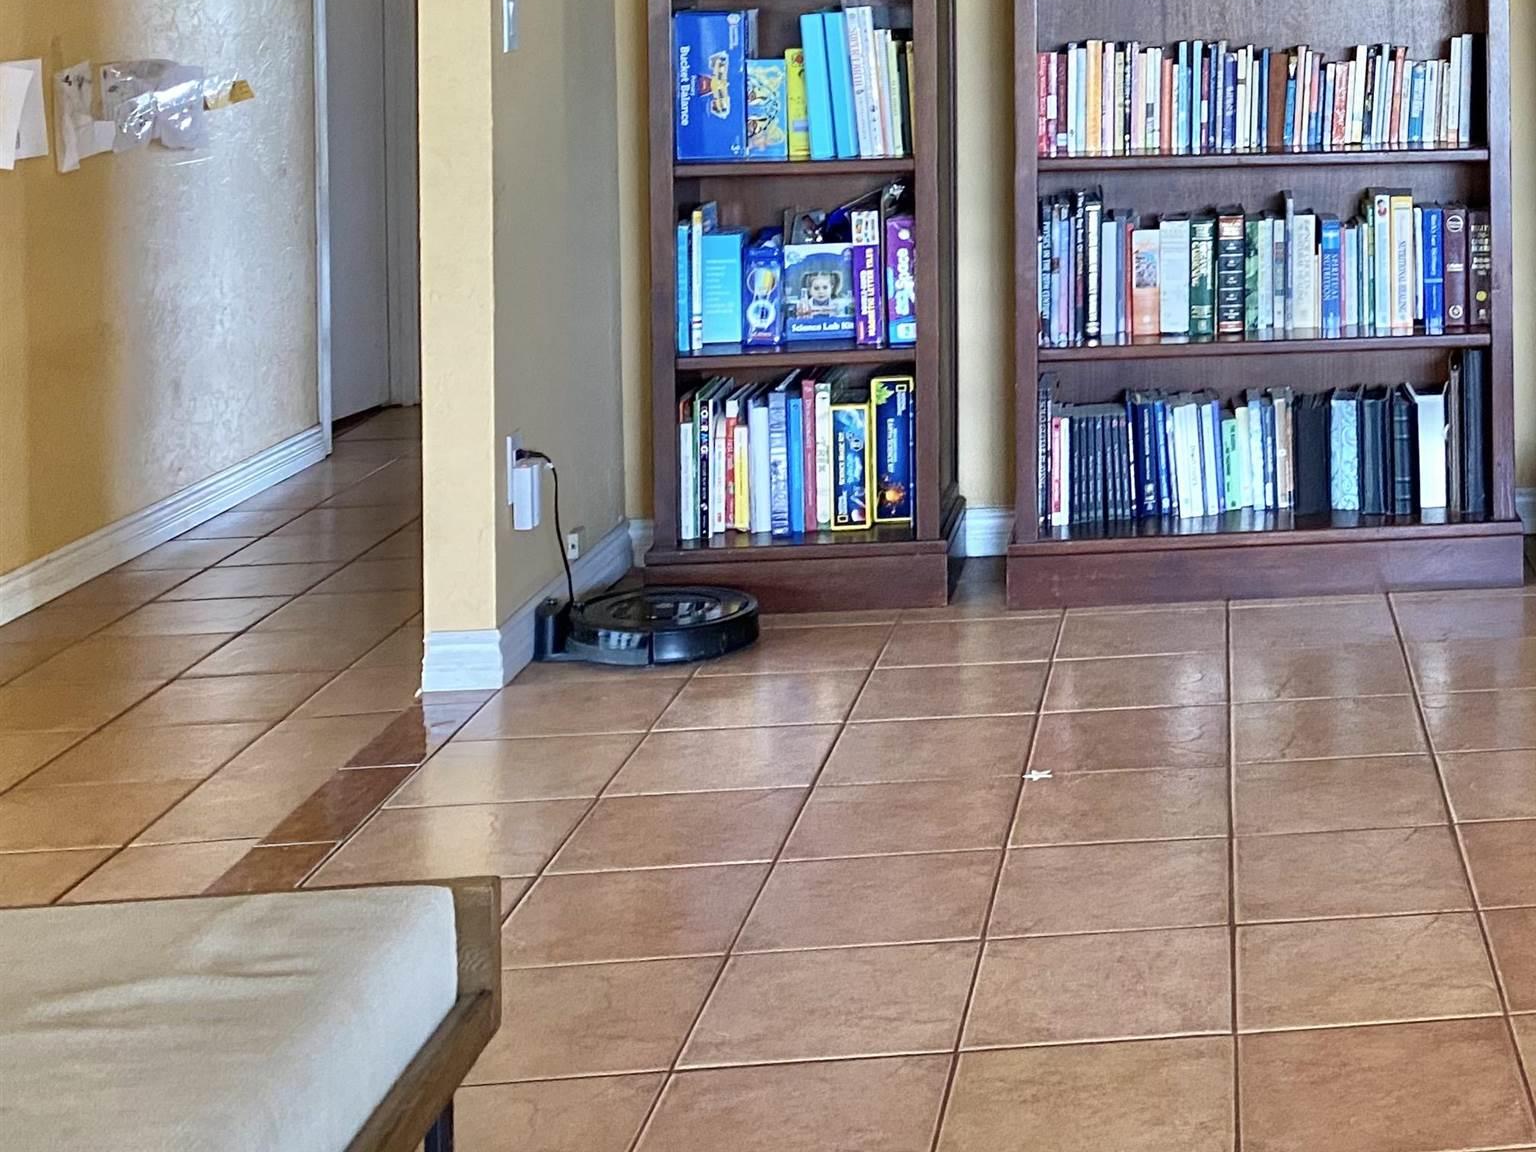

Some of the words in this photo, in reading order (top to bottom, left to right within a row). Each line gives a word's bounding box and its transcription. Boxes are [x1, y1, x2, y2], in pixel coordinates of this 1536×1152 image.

[679, 46, 691, 82] Bucket
[680, 84, 692, 126] Balance
[1042, 221, 1051, 248] PHYSICS
[1323, 254, 1331, 301] NUTRITION
[1331, 254, 1339, 300] SPIRITUAL
[791, 323, 821, 333] Science
[823, 322, 839, 332] Lab
